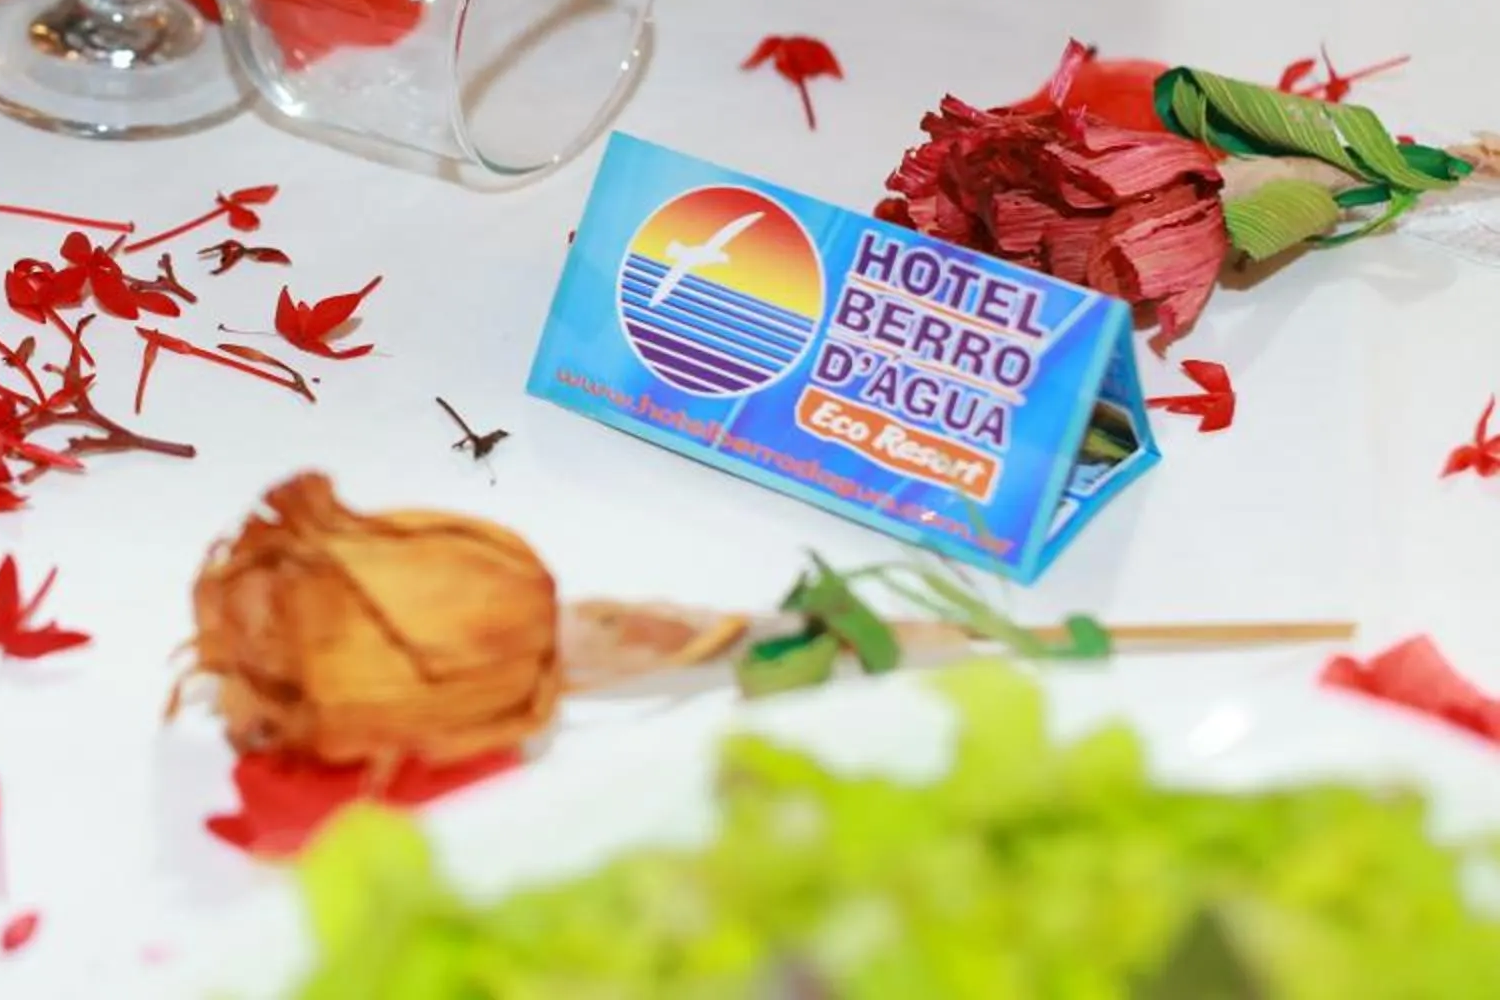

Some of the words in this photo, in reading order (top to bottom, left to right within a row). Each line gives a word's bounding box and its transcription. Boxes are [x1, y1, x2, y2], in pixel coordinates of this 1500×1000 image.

[855, 233, 1044, 339] HOTEL
[834, 287, 1032, 388] BERRO
[809, 399, 871, 442] Eco
[871, 423, 986, 485] Resort
